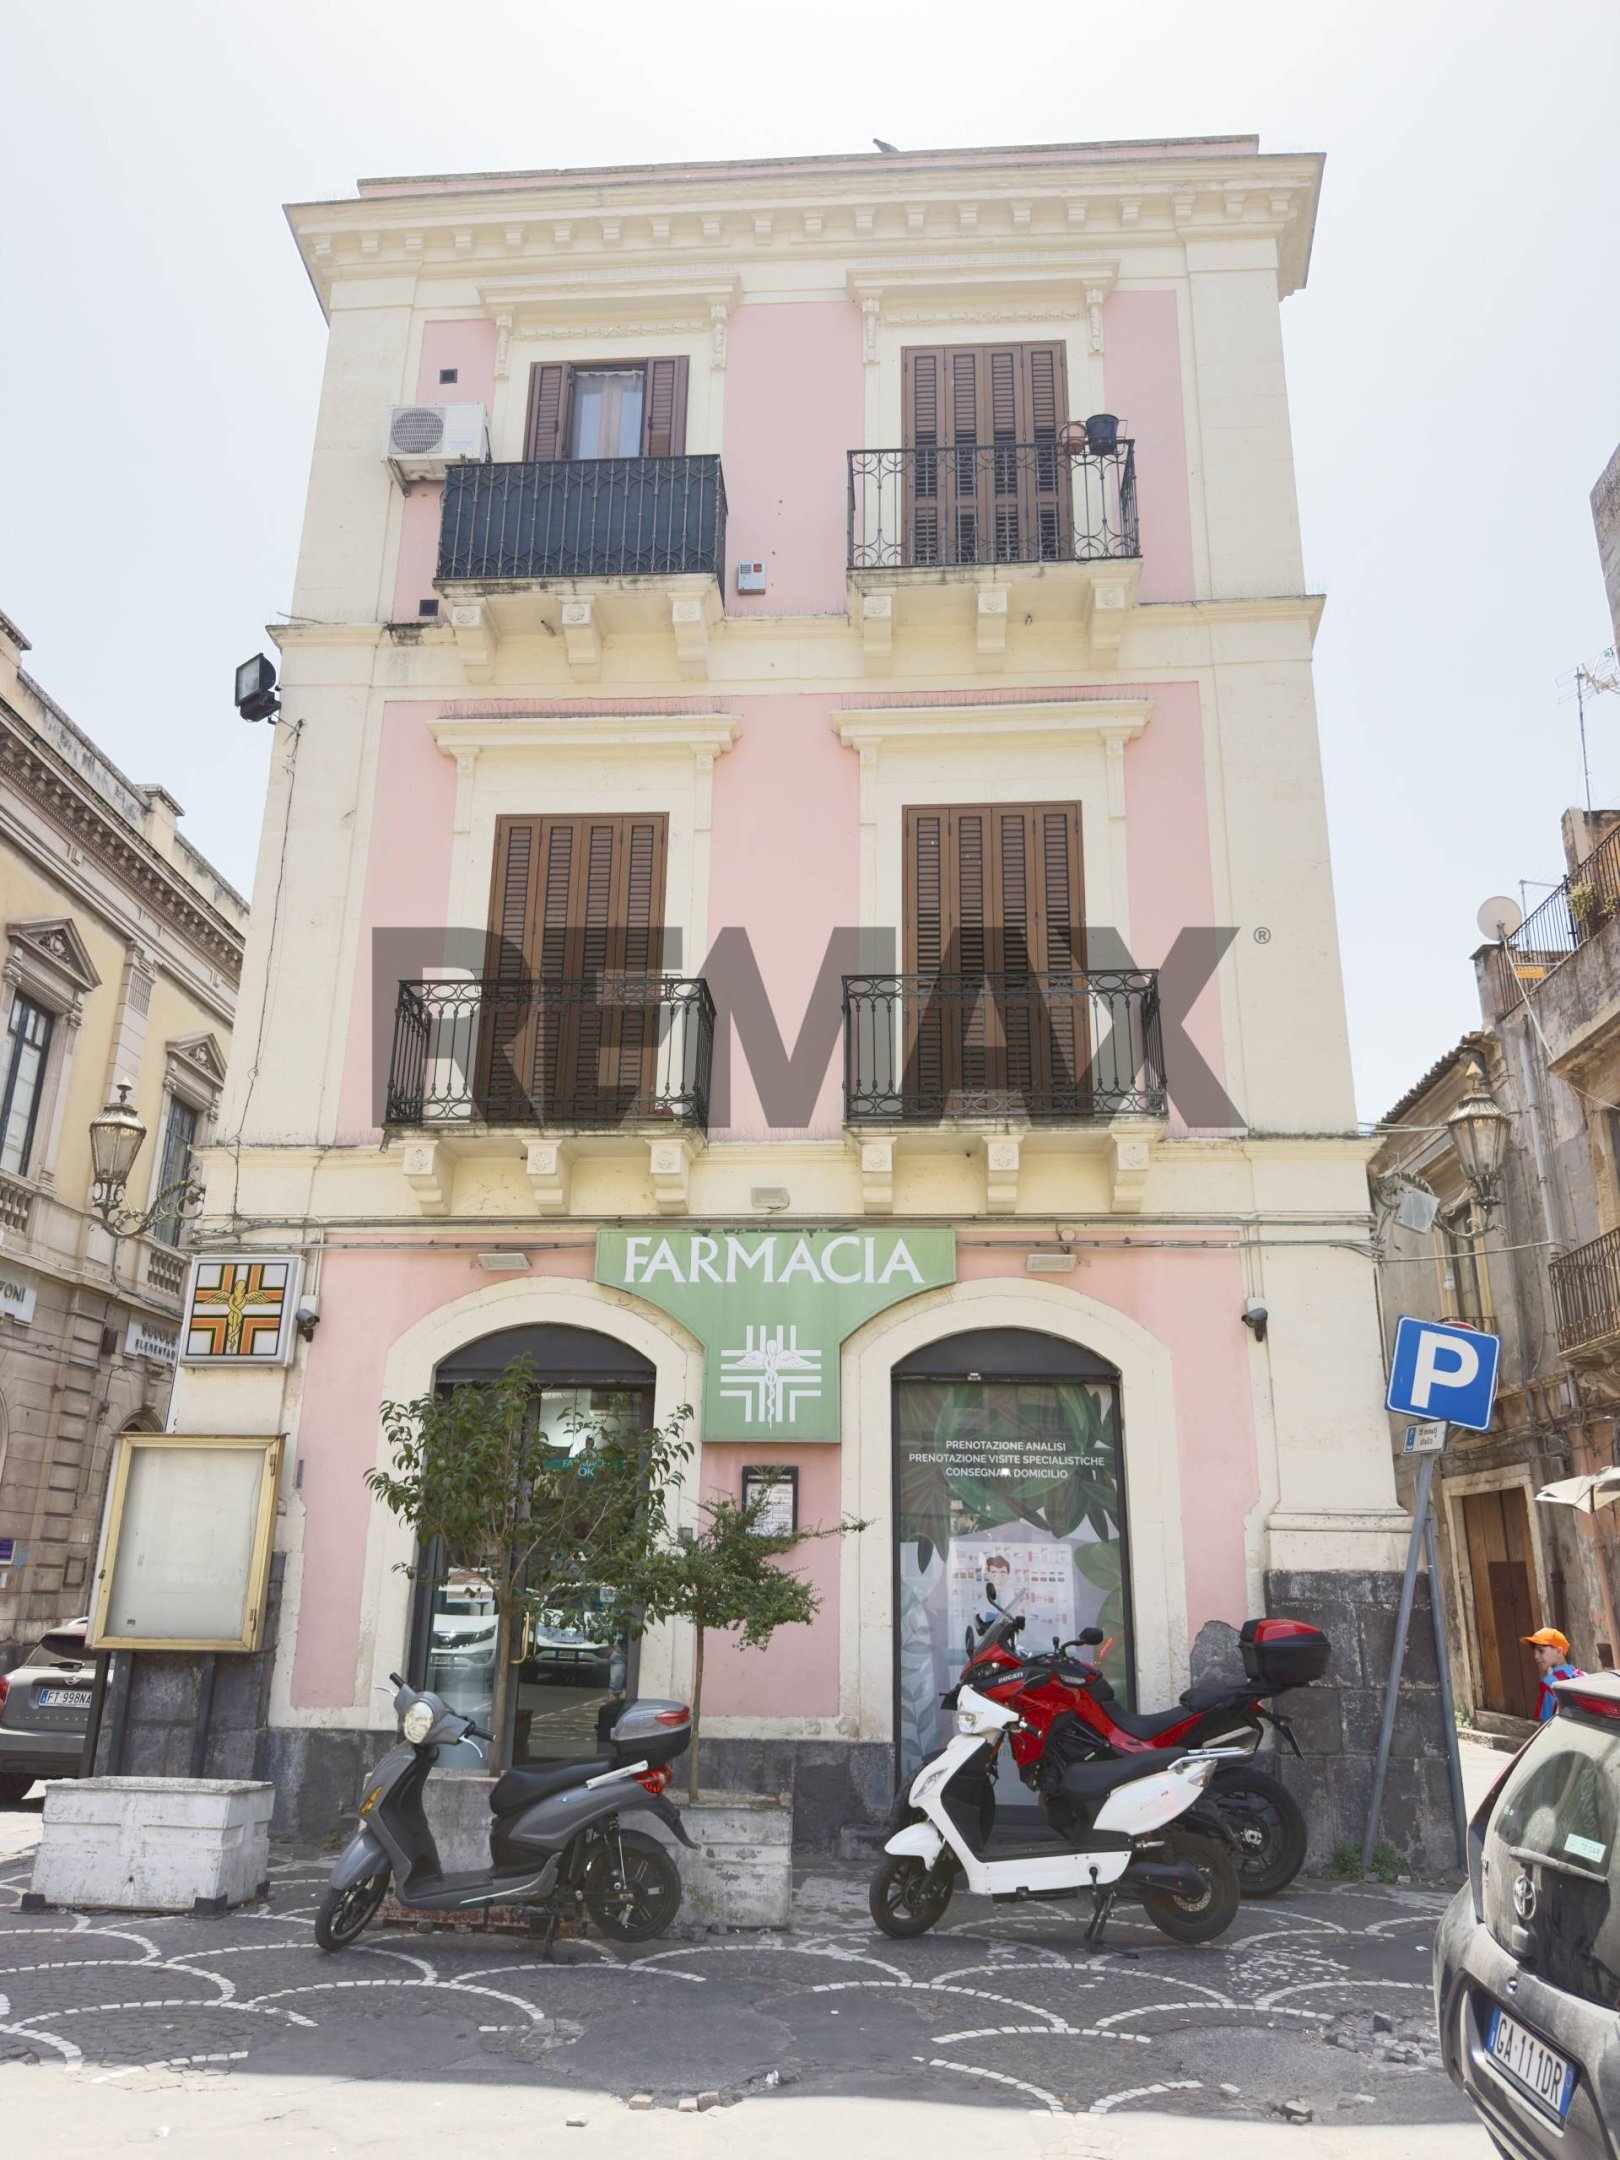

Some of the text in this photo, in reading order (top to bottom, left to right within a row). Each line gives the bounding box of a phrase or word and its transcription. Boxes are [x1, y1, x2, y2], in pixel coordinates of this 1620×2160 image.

[624, 1236, 925, 1283] FARMACIA
[0, 1281, 26, 1303] ONI
[135, 1339, 177, 1361] ELEMENTAR
[1410, 1330, 1479, 1409] P
[946, 1440, 1066, 1451] PRENOTAZIONE ANALISI
[908, 1453, 1105, 1466] PRENOTAZIONE VISITE SPECIALISTICHE
[577, 1467, 595, 1477] OK
[945, 1467, 1003, 1478] CONSEGNA
[1013, 1468, 1068, 1479] DOMICILIO
[998, 1671, 1023, 1684] DUCATI
[1496, 2018, 1562, 2105] GA 111DR
